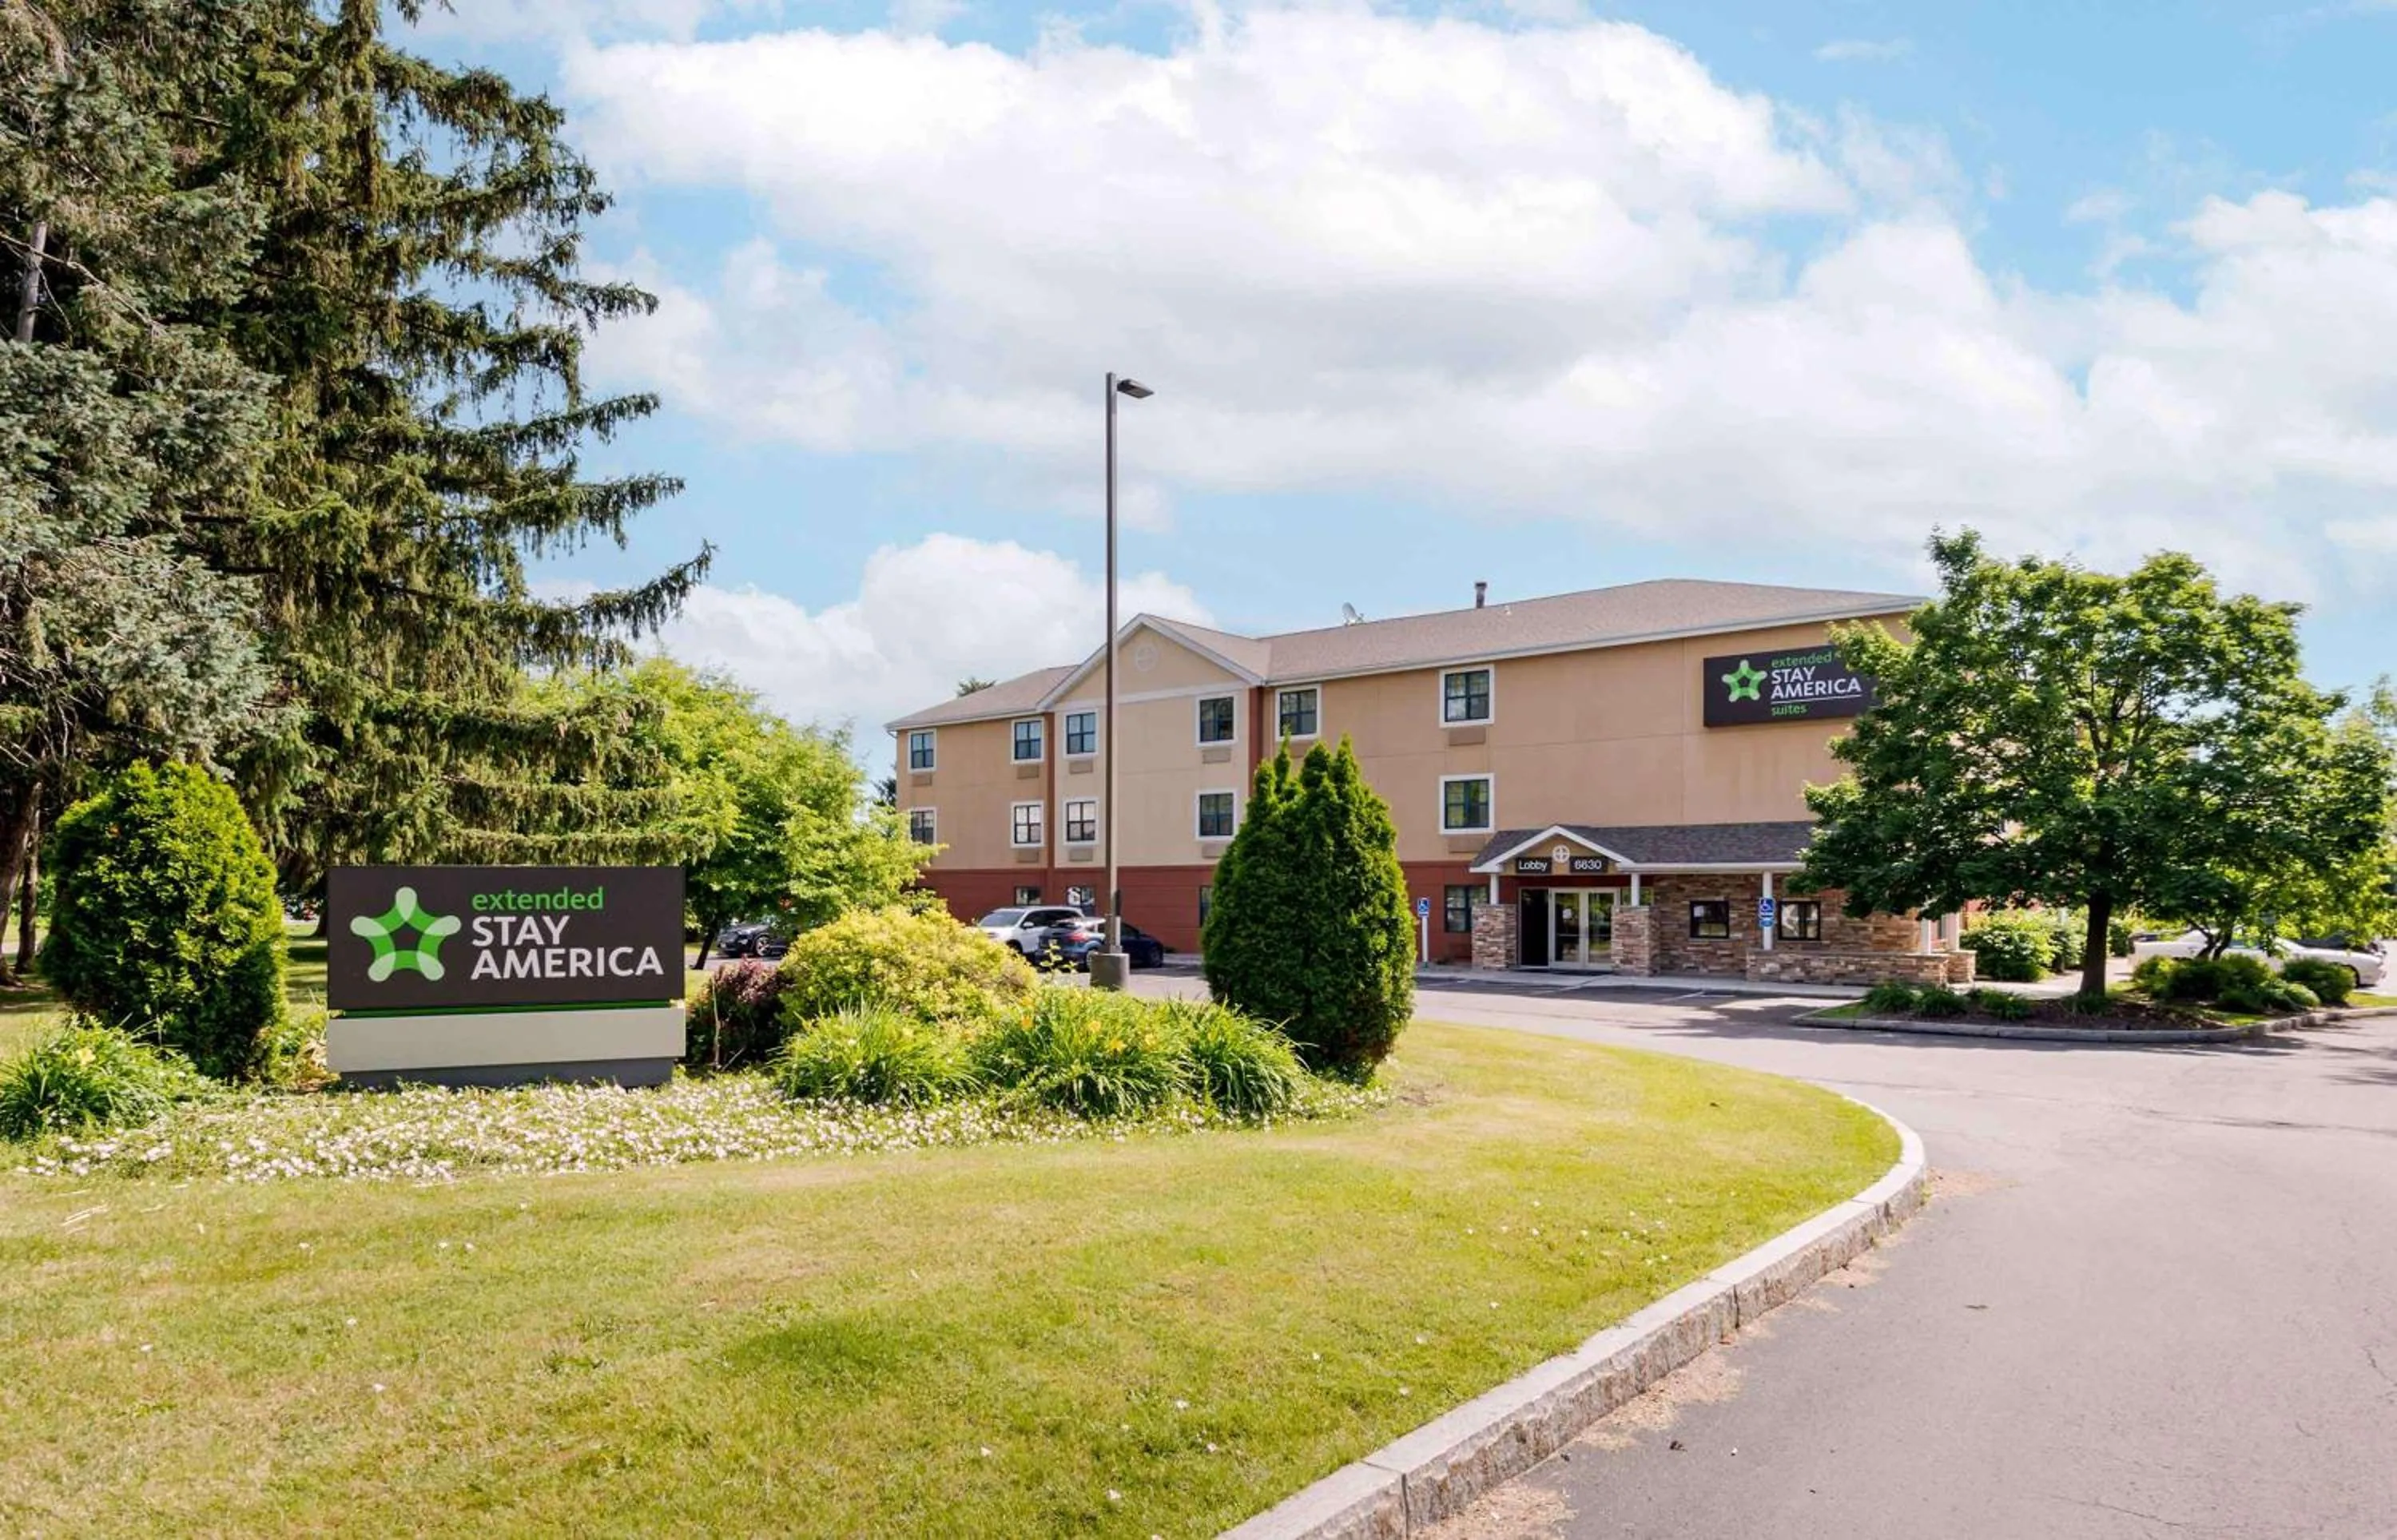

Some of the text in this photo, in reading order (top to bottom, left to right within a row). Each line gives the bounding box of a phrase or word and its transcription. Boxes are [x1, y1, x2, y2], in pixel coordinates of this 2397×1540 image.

[1771, 651, 1832, 668] extended
[1771, 665, 1816, 685] STAY
[1771, 677, 1862, 699] AMERICA
[1771, 705, 1807, 716] suites
[1519, 859, 1548, 872] Lobby
[471, 886, 604, 911] extended
[471, 915, 570, 947] STAY
[471, 947, 664, 981] AMERICA
